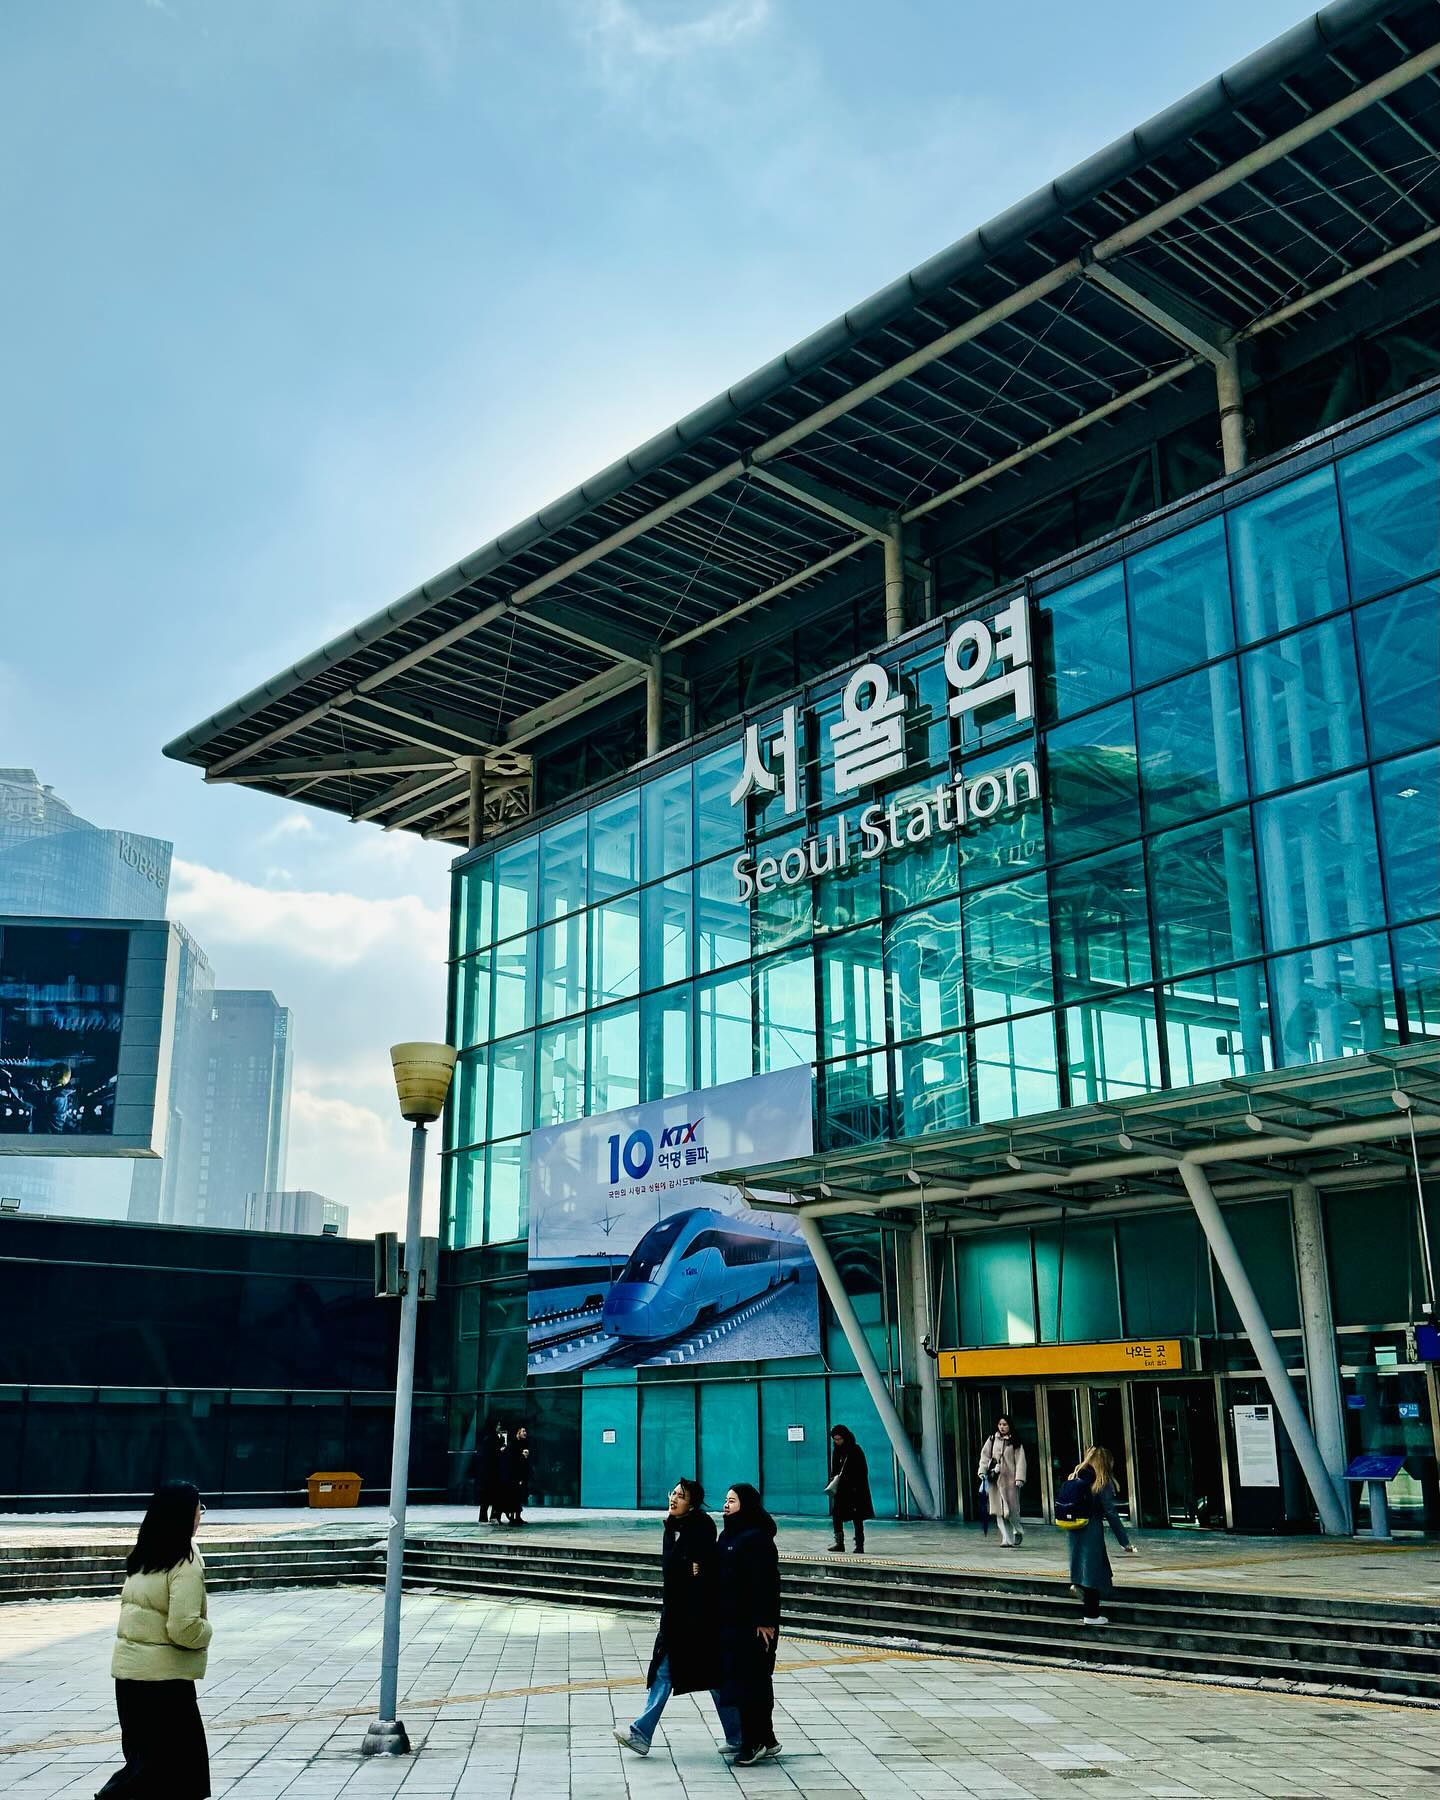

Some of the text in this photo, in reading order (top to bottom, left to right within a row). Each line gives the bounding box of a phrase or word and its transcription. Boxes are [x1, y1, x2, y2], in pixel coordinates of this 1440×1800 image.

[730, 595, 1035, 817] 서울역
[732, 760, 1040, 903] Seoul Station
[660, 1117, 705, 1148] KTX
[608, 1129, 654, 1185] 10
[658, 1146, 709, 1170] 억명 돌파
[950, 1345, 1166, 1374] 1 나오는 곳
